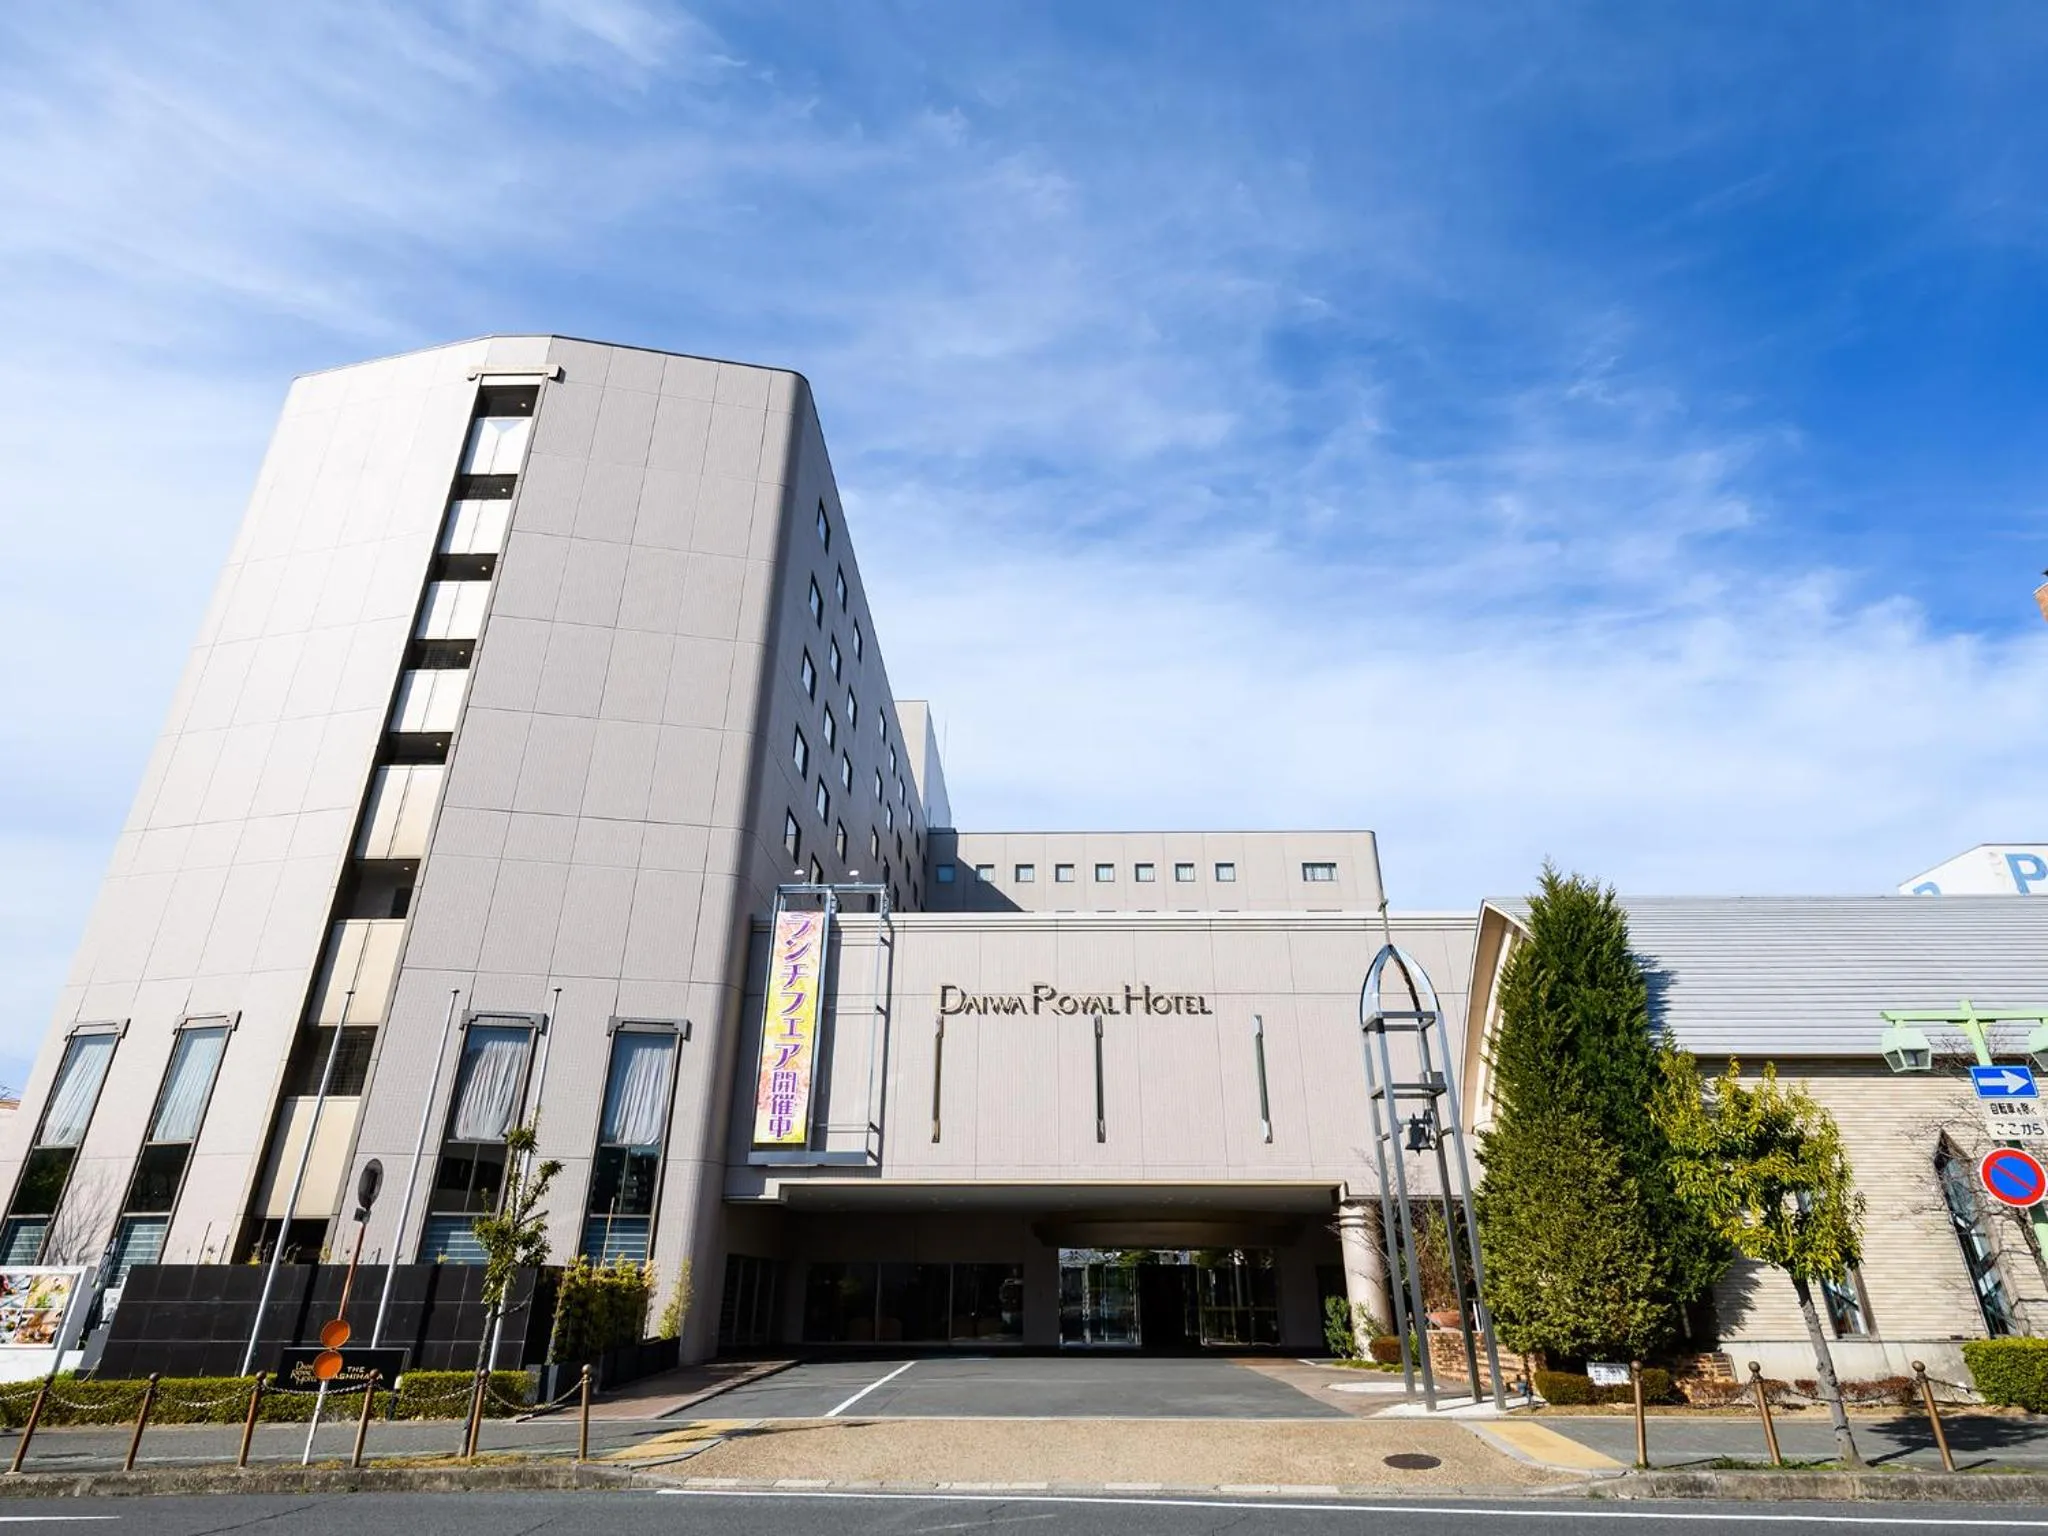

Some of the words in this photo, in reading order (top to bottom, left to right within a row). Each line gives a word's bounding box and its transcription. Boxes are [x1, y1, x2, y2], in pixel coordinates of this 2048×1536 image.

[2004, 853, 2048, 896] P
[940, 984, 1028, 1015] DAIWA
[1032, 984, 1121, 1015] ROYAL
[1124, 984, 1213, 1015] HOTEL
[768, 914, 812, 1140] ランチフェア開催中
[1995, 1123, 2045, 1135] ここから
